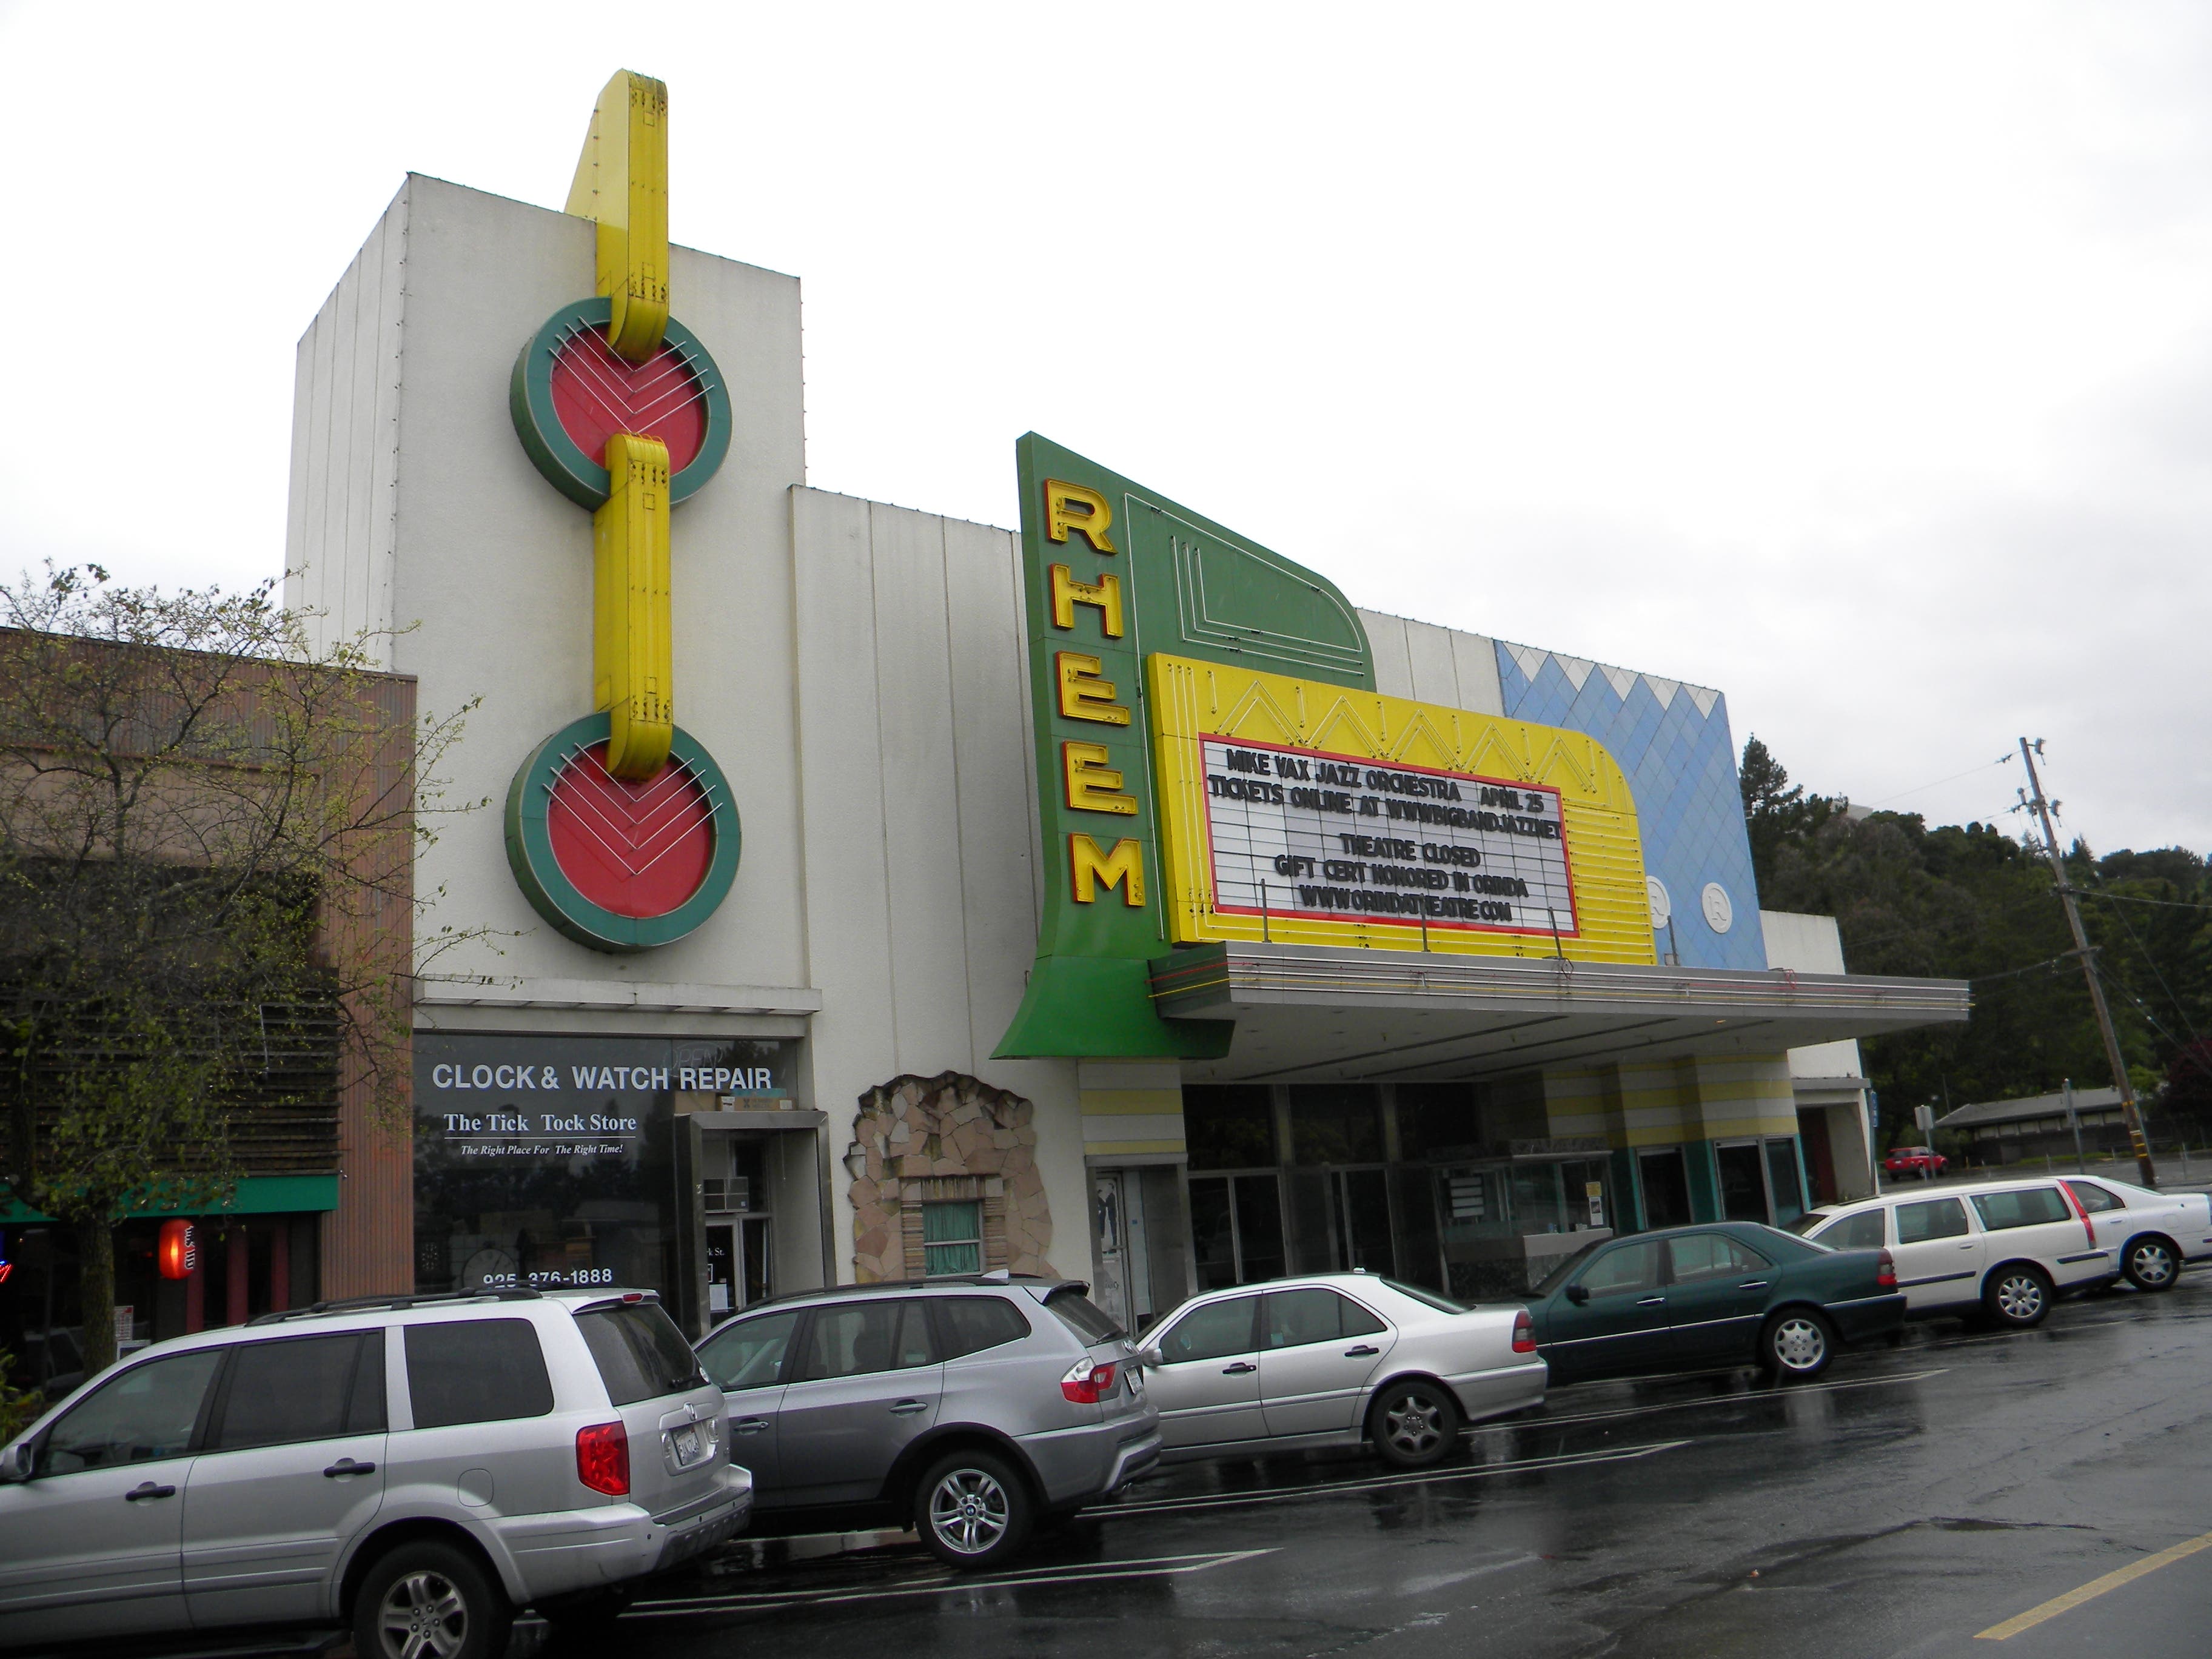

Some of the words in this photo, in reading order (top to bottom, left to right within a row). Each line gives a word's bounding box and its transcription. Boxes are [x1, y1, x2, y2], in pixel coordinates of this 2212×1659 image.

[1044, 477, 1146, 907] RHEEM
[1208, 774, 1284, 805] TICKETS
[1291, 786, 1353, 814] ONLINE
[1360, 795, 1380, 817] AT
[1227, 749, 1270, 776] MIKE
[1275, 756, 1310, 781] VAX
[1316, 763, 1362, 788] JAZZ
[1366, 770, 1463, 802] ORCHESTRA
[1480, 786, 1523, 810] APRIL
[1526, 793, 1544, 813] 25
[1339, 833, 1417, 861] THEATRE
[1423, 843, 1481, 867] CLOSED
[1275, 854, 1315, 878] GIFT
[1323, 859, 1366, 883] CERT
[1372, 863, 1449, 890] HONORED
[1453, 871, 1470, 892] IN
[1473, 874, 1529, 897] ORINDA
[432, 1064, 535, 1089] CLOCK
[541, 1066, 560, 1089] &
[571, 1066, 668, 1090] WATCH
[680, 1067, 772, 1090] REPAIR
[443, 1113, 481, 1131] The
[486, 1114, 530, 1131] Tick
[541, 1114, 586, 1131] Tock
[589, 1114, 637, 1131] Store
[461, 1145, 478, 1155] The
[480, 1145, 504, 1156] Right
[507, 1145, 531, 1155] Place
[533, 1145, 549, 1155] For
[555, 1145, 571, 1155] The
[574, 1145, 598, 1156] Right
[599, 1144, 623, 1154] Time!
[483, 1273, 516, 1288] 925
[528, 1268, 612, 1287] 376-1888
